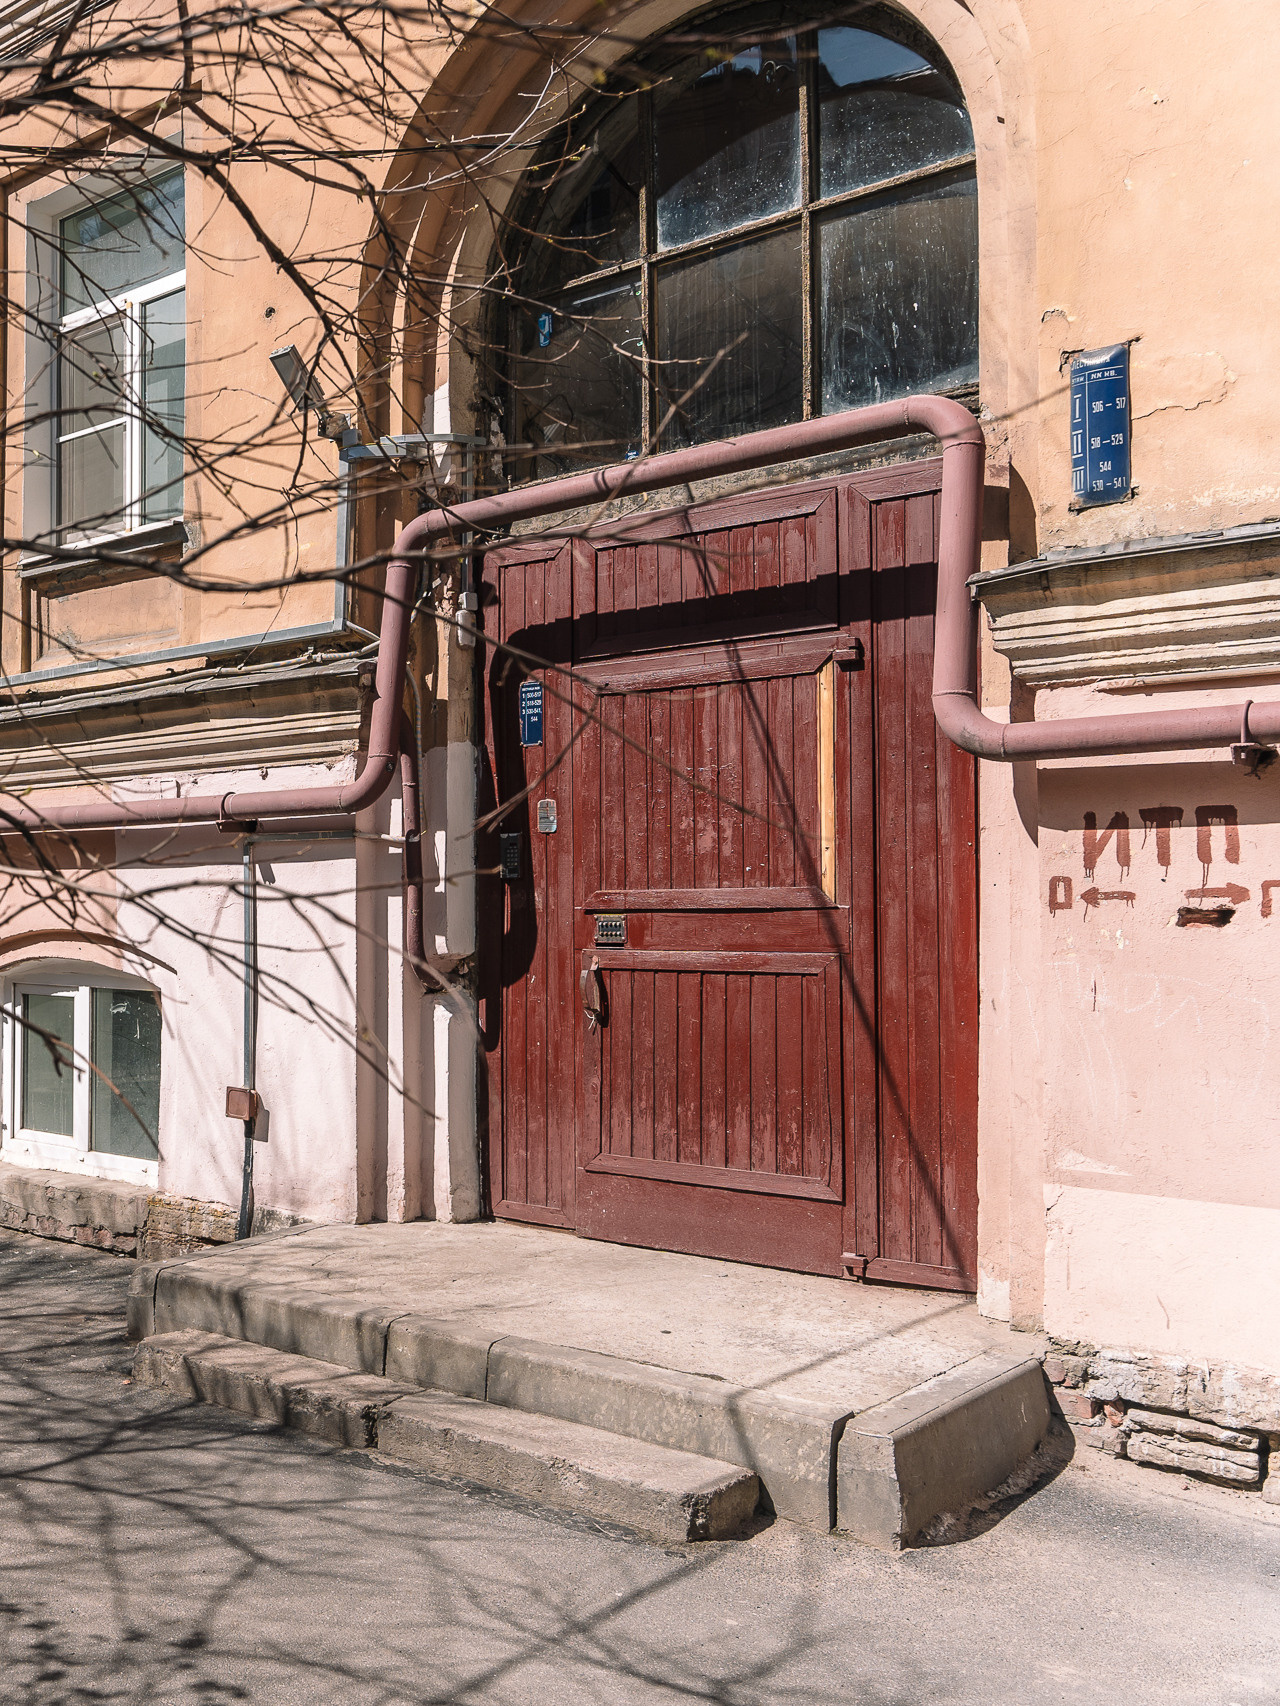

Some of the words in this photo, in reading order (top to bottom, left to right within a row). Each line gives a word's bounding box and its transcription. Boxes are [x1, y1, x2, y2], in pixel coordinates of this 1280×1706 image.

[1073, 394, 1082, 423] I
[1072, 429, 1083, 459] II
[1072, 466, 1085, 494] III
[1083, 805, 1240, 876] ИТП
